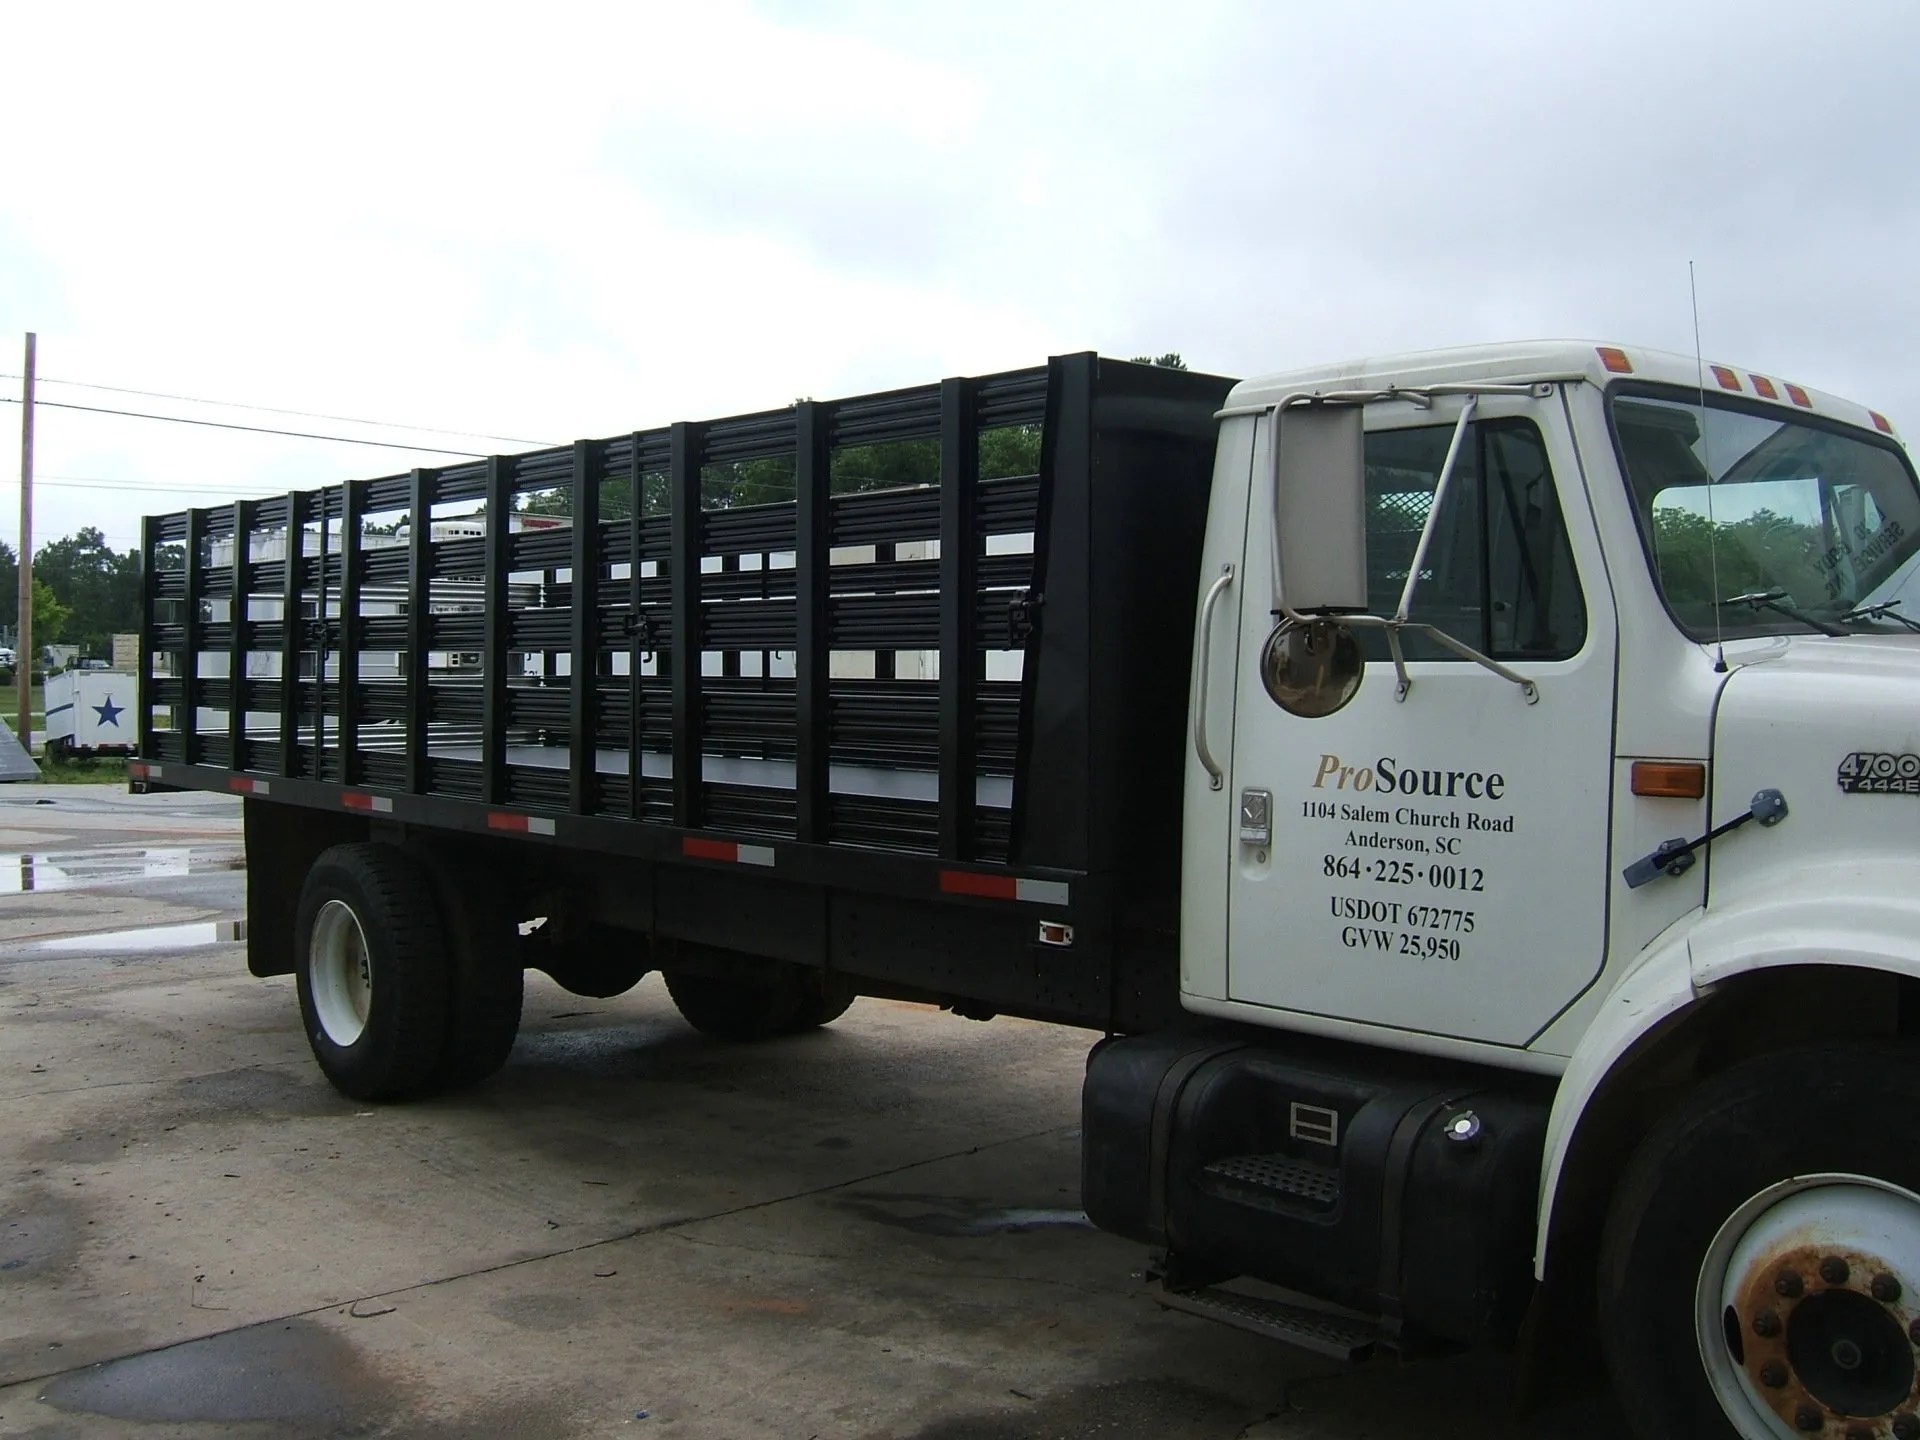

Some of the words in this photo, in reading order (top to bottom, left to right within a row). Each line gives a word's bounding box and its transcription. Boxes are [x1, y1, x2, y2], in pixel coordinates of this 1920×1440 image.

[1312, 754, 1505, 800] ProSource
[1838, 752, 1920, 778] 4700
[1302, 801, 1336, 819] 1104
[1340, 804, 1390, 824] Salem
[1395, 807, 1460, 829] Church
[1467, 812, 1515, 833] Road
[1344, 830, 1430, 856] Anderson,
[1435, 836, 1462, 855] SC
[1331, 896, 1402, 924] USDOT
[1407, 905, 1476, 933] 672775
[1342, 926, 1394, 952] GVW
[1400, 933, 1461, 961] 25,950
